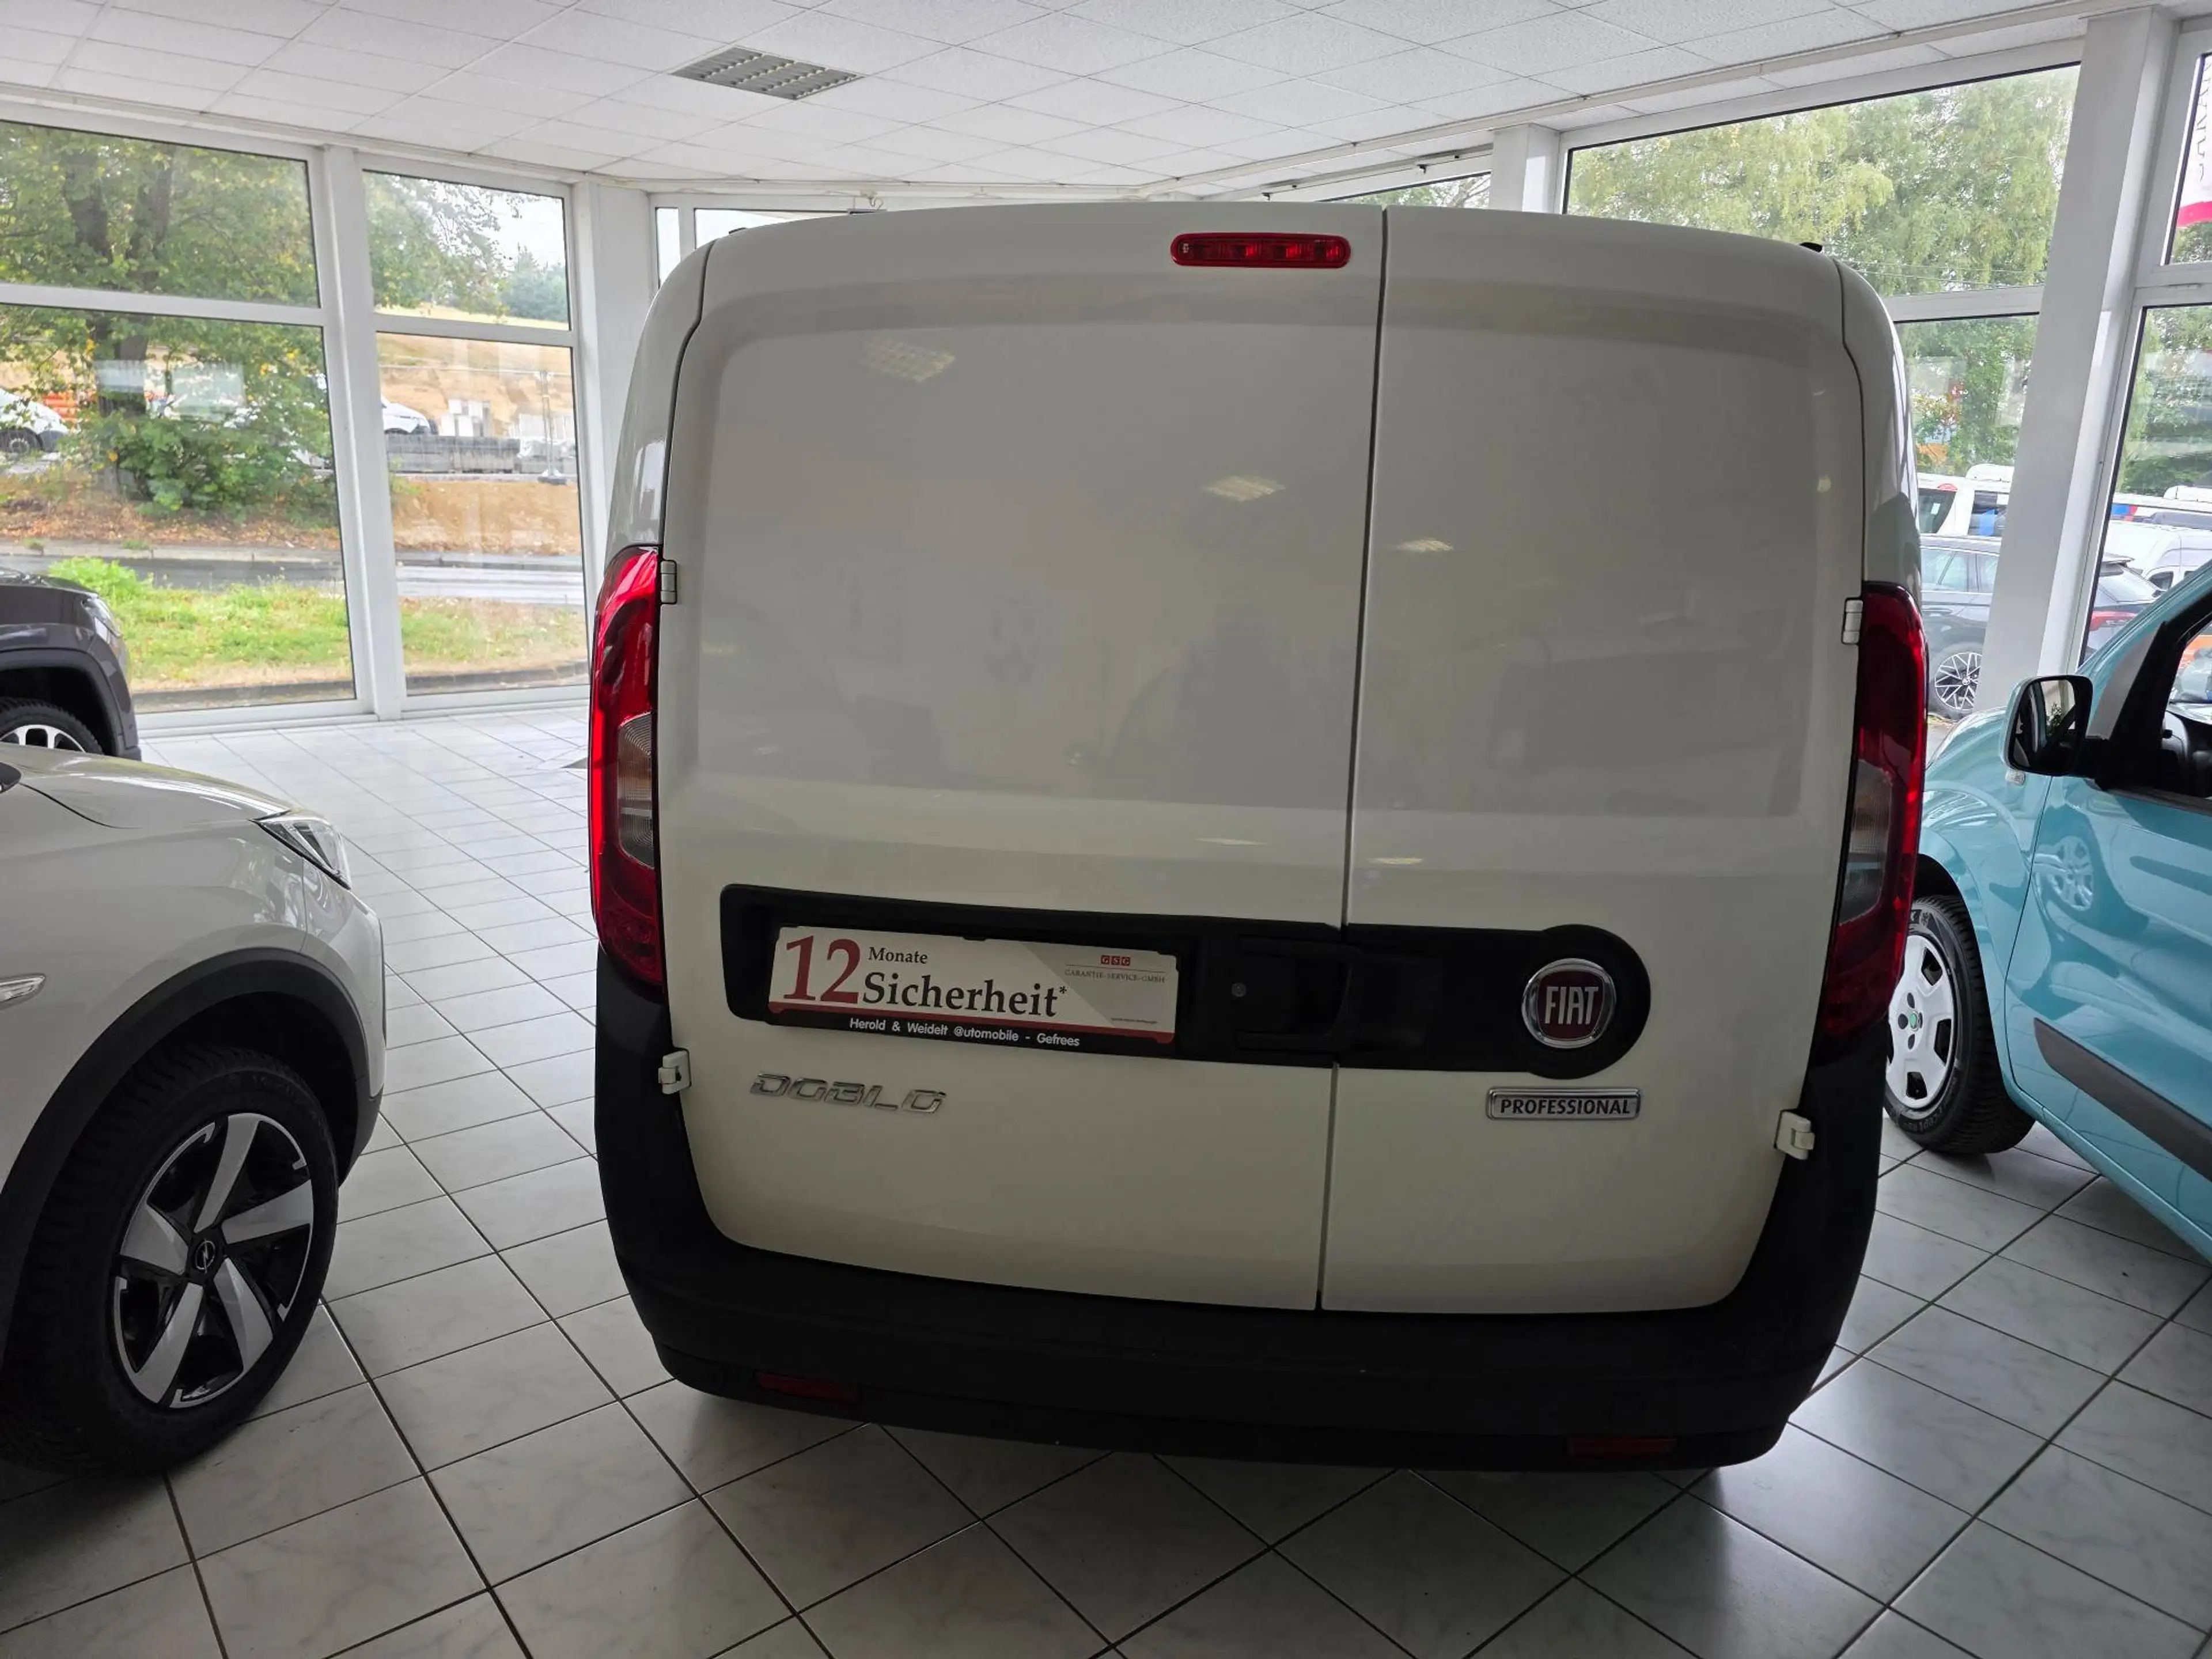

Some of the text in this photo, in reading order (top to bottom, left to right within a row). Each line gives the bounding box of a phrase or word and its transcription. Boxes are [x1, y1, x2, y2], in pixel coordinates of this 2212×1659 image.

[783, 935, 861, 1004] 12
[868, 946, 928, 964] Monate
[1544, 986, 1599, 1025] FIAT
[850, 1017, 886, 1031] Herold
[892, 1021, 900, 1031] &
[907, 1022, 948, 1036] Weidelt
[954, 1025, 1018, 1041] @utomobile
[1037, 1032, 1080, 1046] Gefrees
[750, 1073, 946, 1114] DOBLO
[1500, 1098, 1630, 1115] PROFESSIONAL
